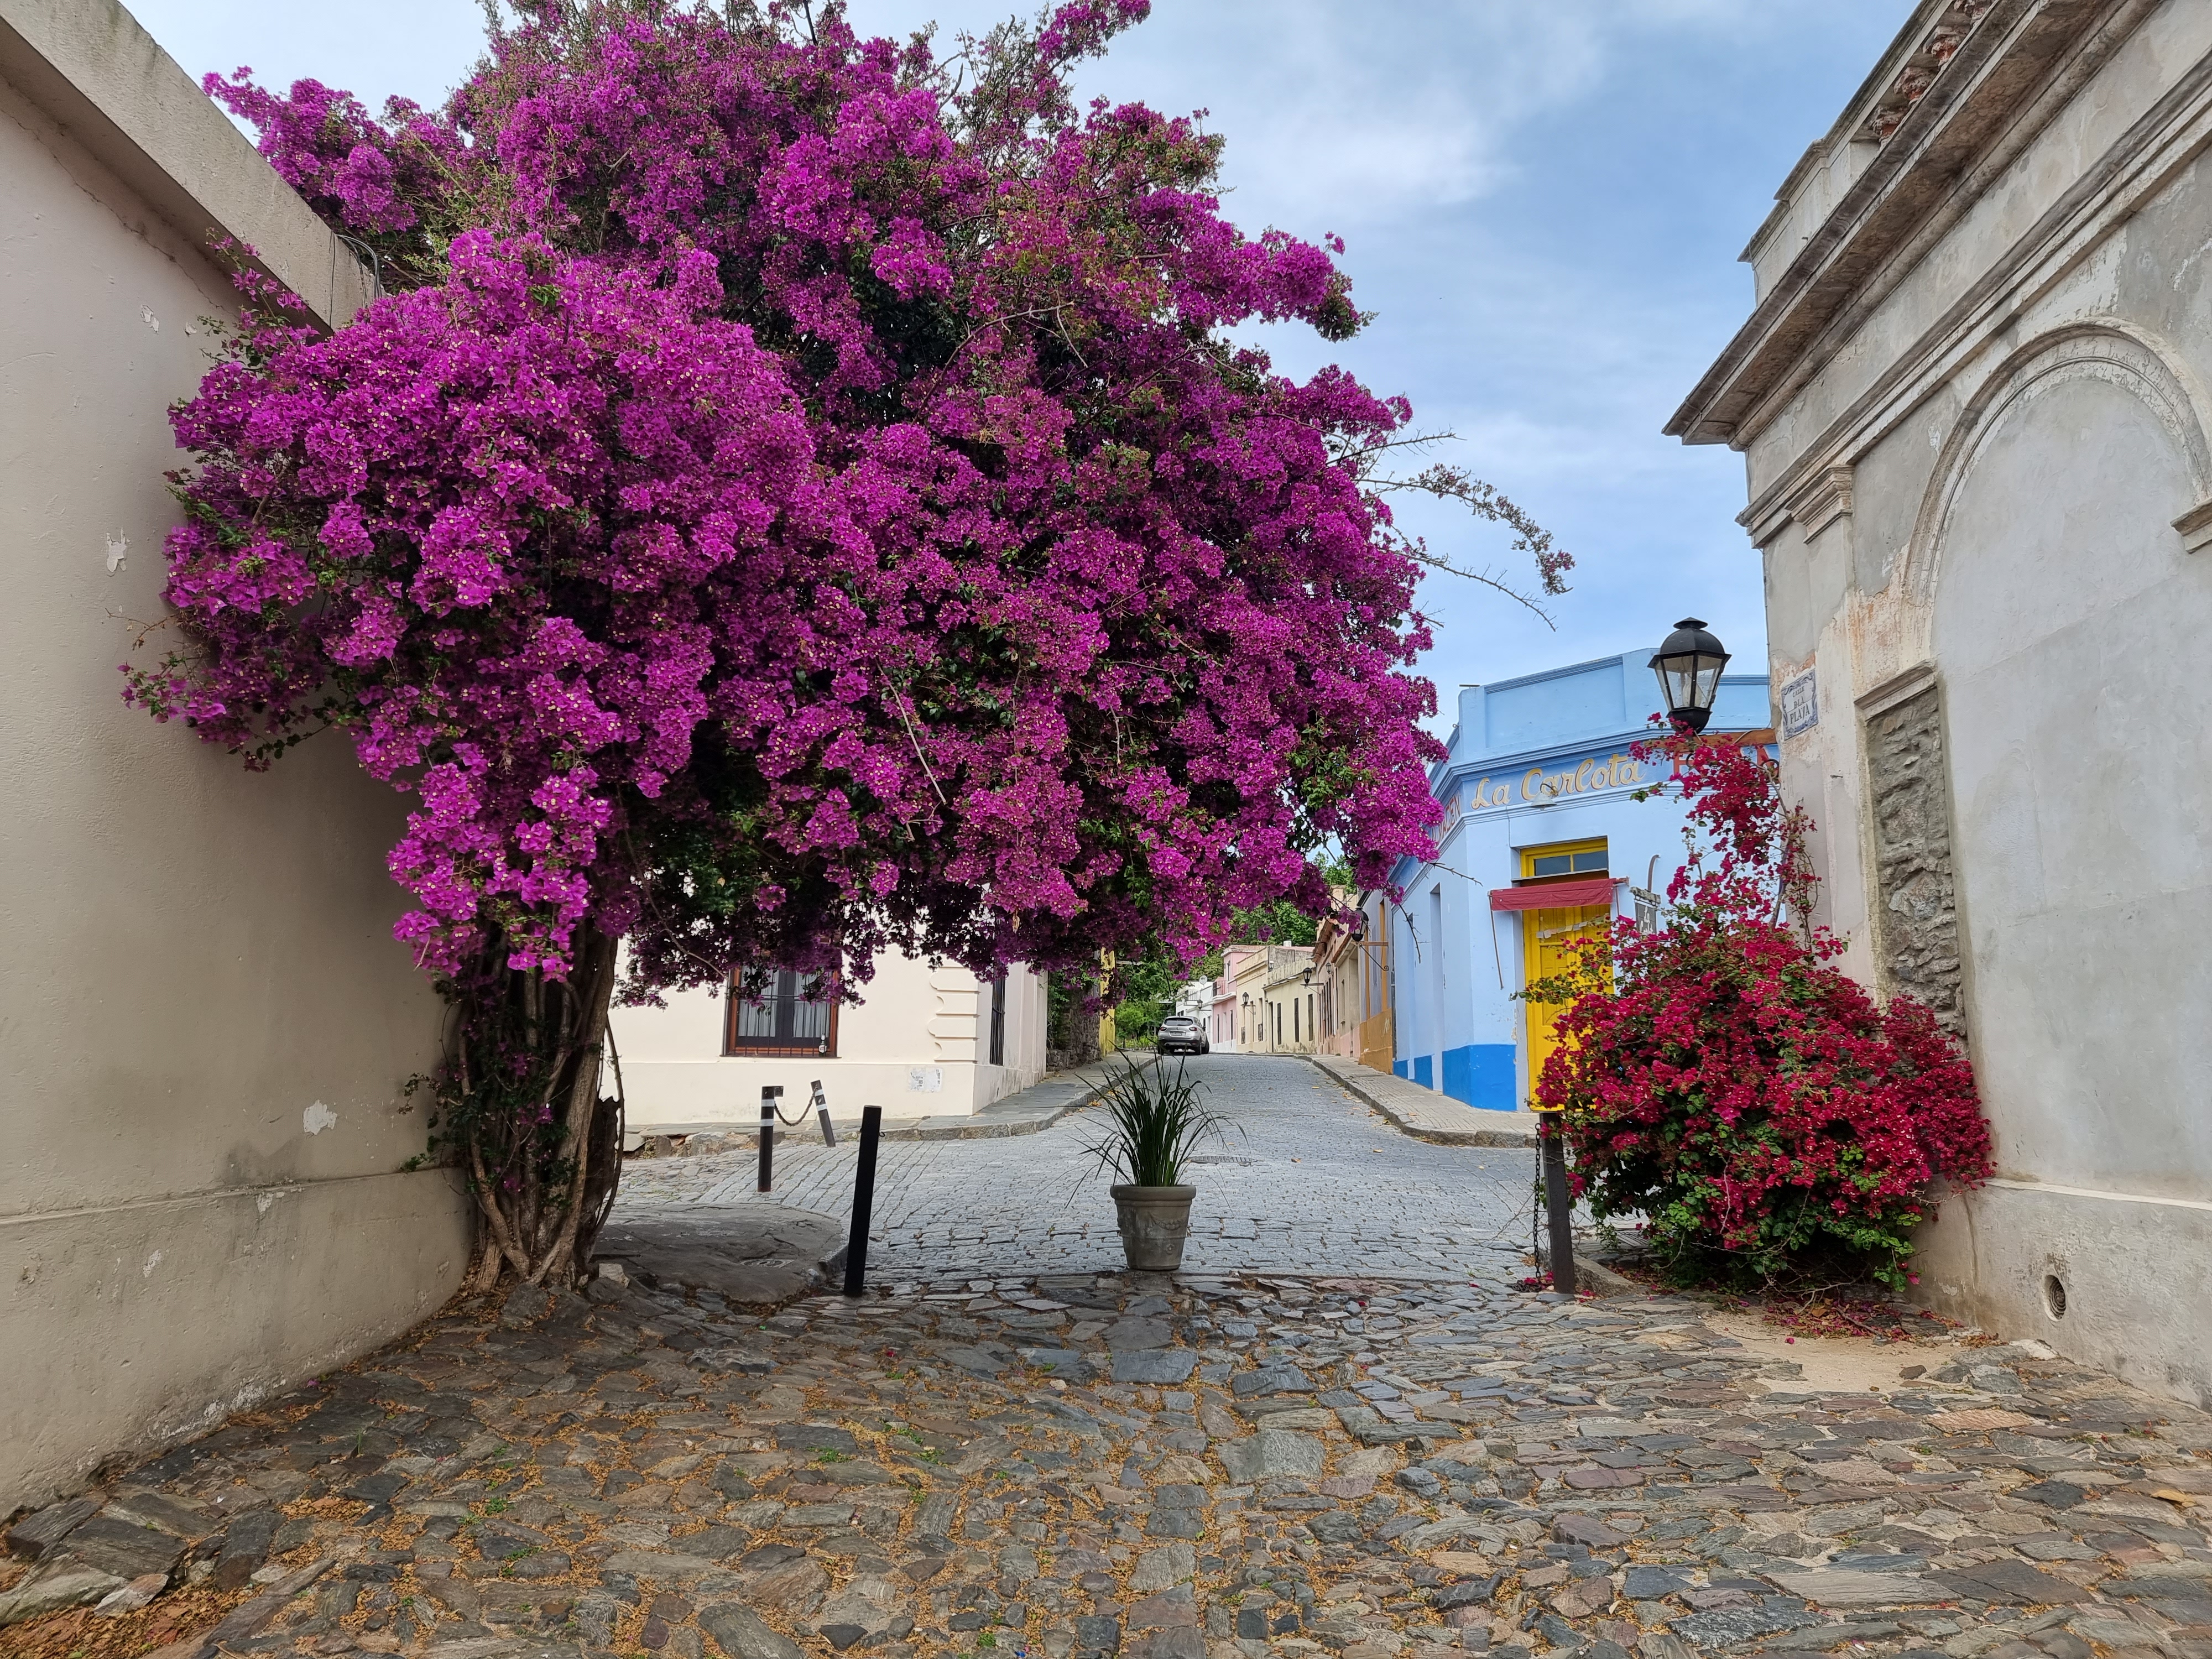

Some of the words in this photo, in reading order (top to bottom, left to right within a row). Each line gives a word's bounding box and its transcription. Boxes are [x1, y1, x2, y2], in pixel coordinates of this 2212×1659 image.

[1793, 686, 1804, 697] CALLE
[1790, 703, 1810, 724] PLAYA
[1471, 777, 1512, 810] La
[1521, 753, 1646, 801] Carlota
